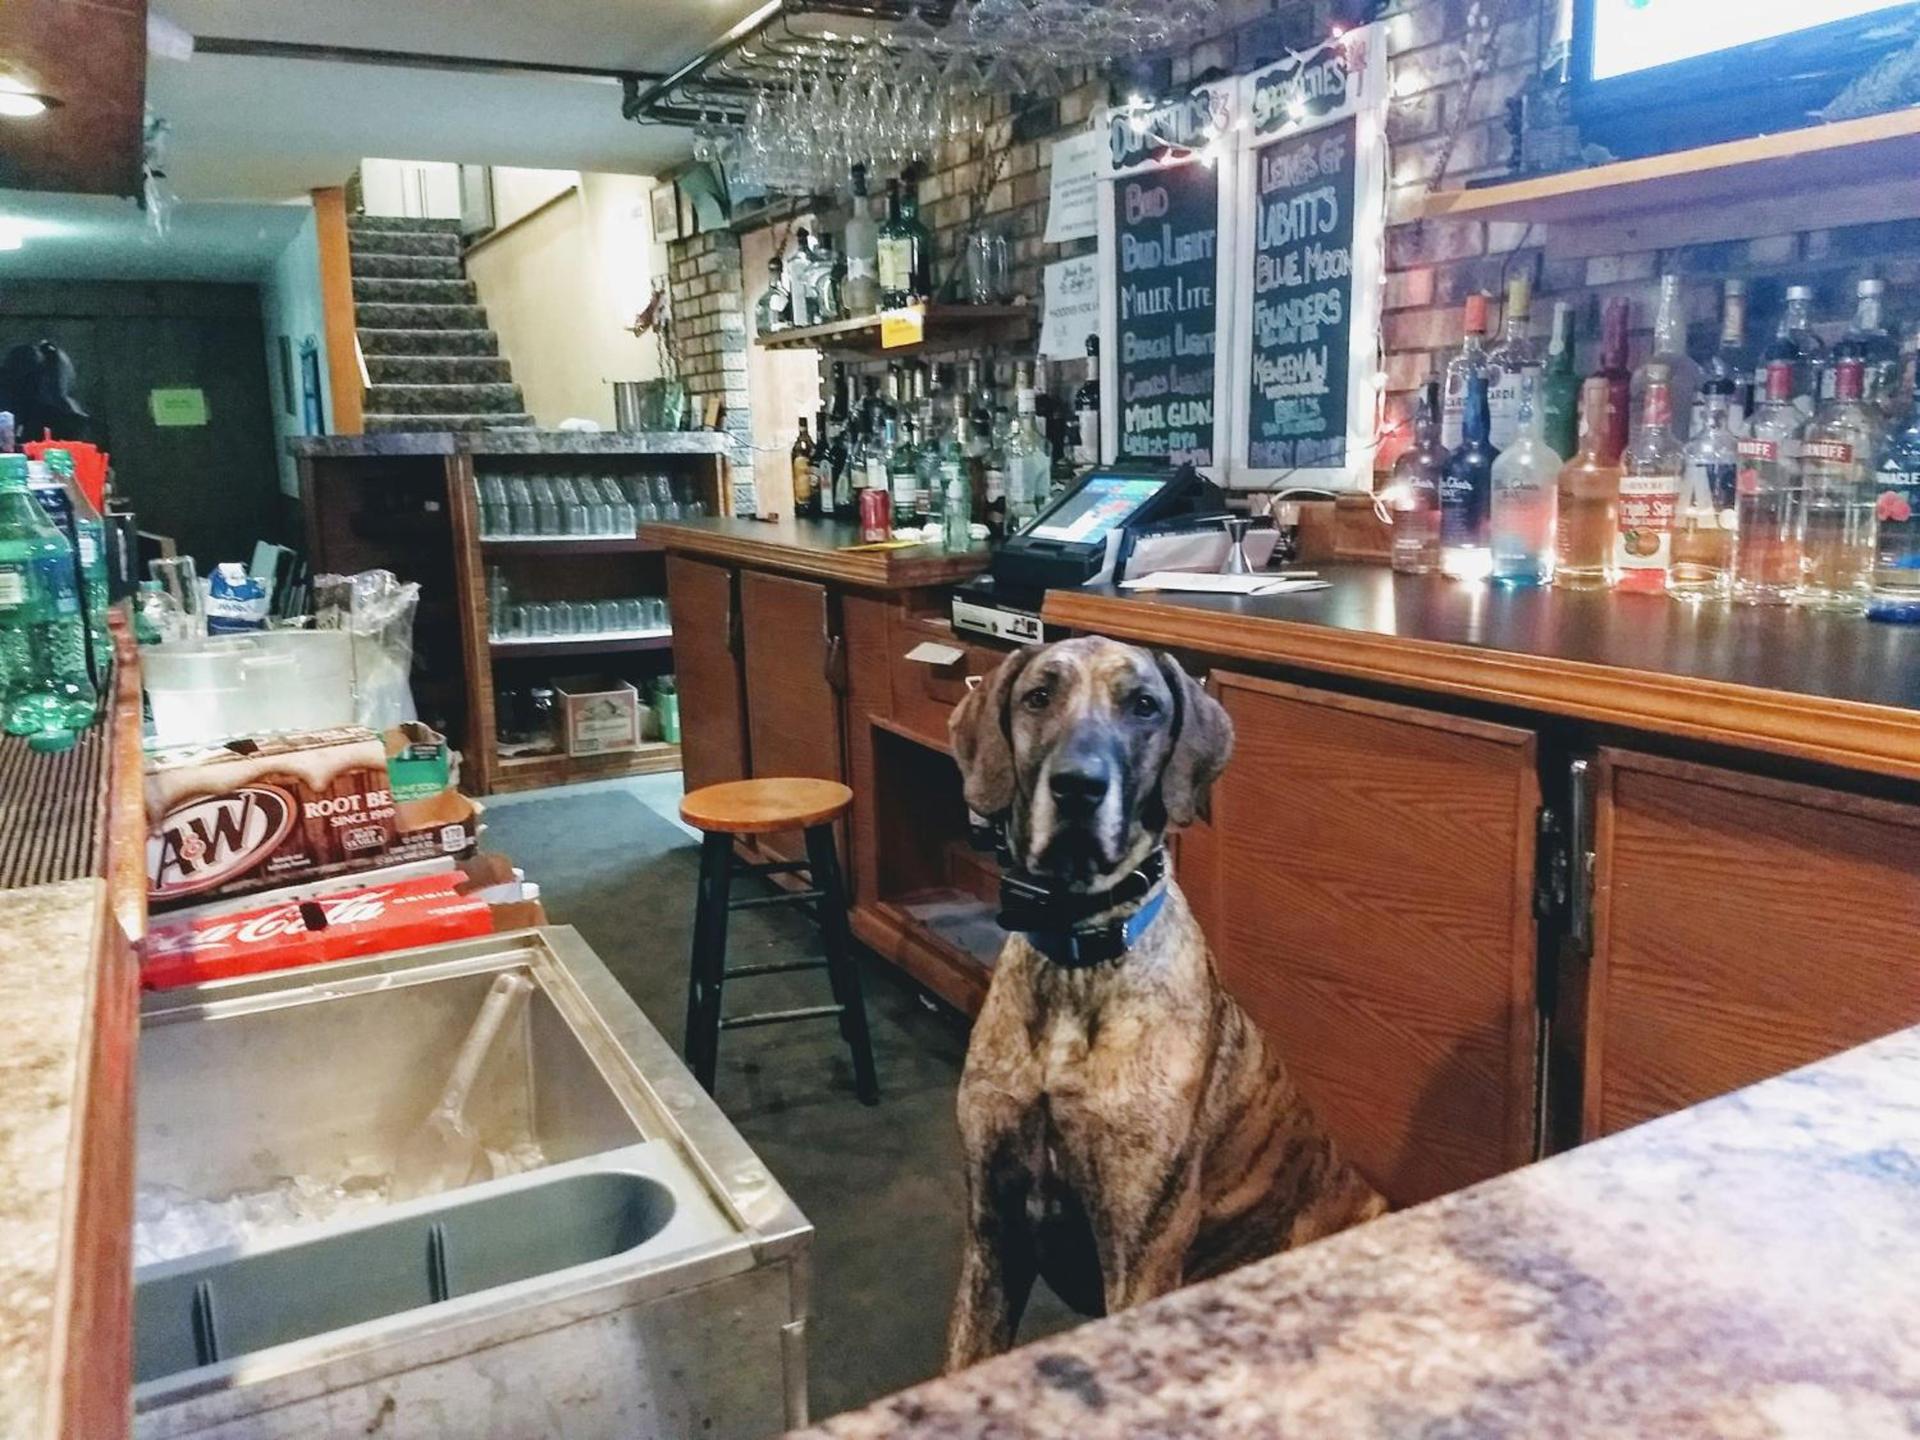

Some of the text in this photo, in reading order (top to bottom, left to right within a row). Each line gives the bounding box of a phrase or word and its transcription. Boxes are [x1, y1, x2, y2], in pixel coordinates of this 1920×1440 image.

[1125, 183, 1168, 225] BUD
[1121, 223, 1216, 272] BUD LIGHT
[1255, 242, 1353, 293] BLUE MOON
[1121, 276, 1213, 320] MILLER LITE
[1254, 288, 1343, 335] FOUNDERS
[304, 795, 361, 819] ROOT
[330, 812, 369, 828] SINCE
[155, 791, 256, 890] A&W
